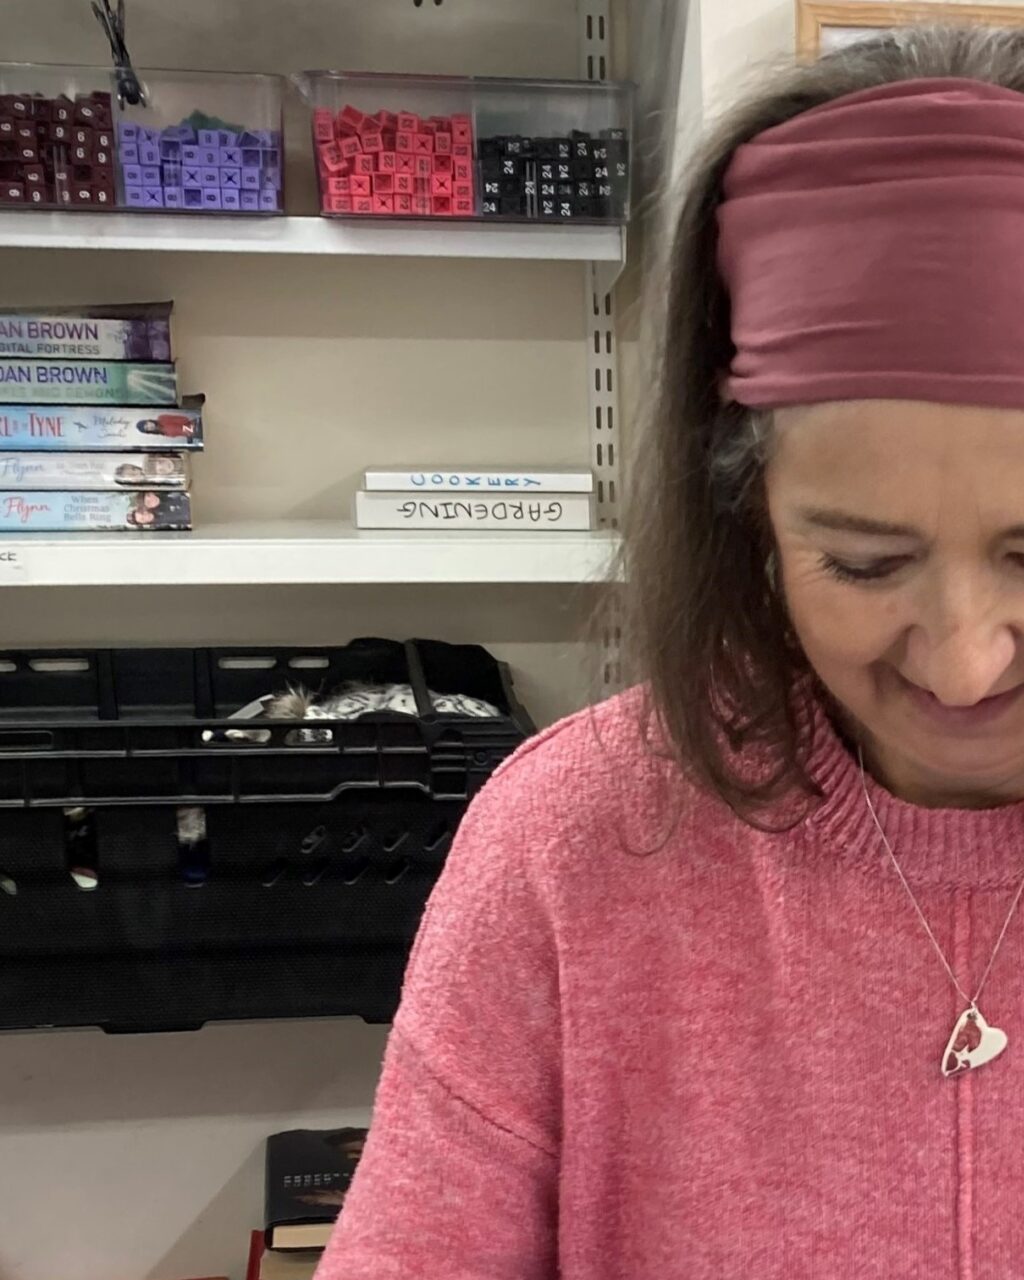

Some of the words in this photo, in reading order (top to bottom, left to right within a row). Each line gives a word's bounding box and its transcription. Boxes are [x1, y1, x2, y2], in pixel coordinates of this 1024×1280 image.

[27, 322, 98, 340] BROWN
[37, 343, 99, 355] FORTRESS
[36, 366, 107, 384] BROWN
[28, 412, 65, 437] TYNE
[410, 474, 541, 487] COOKERY
[3, 496, 51, 523] Flynn
[397, 501, 563, 522] GARDENING
